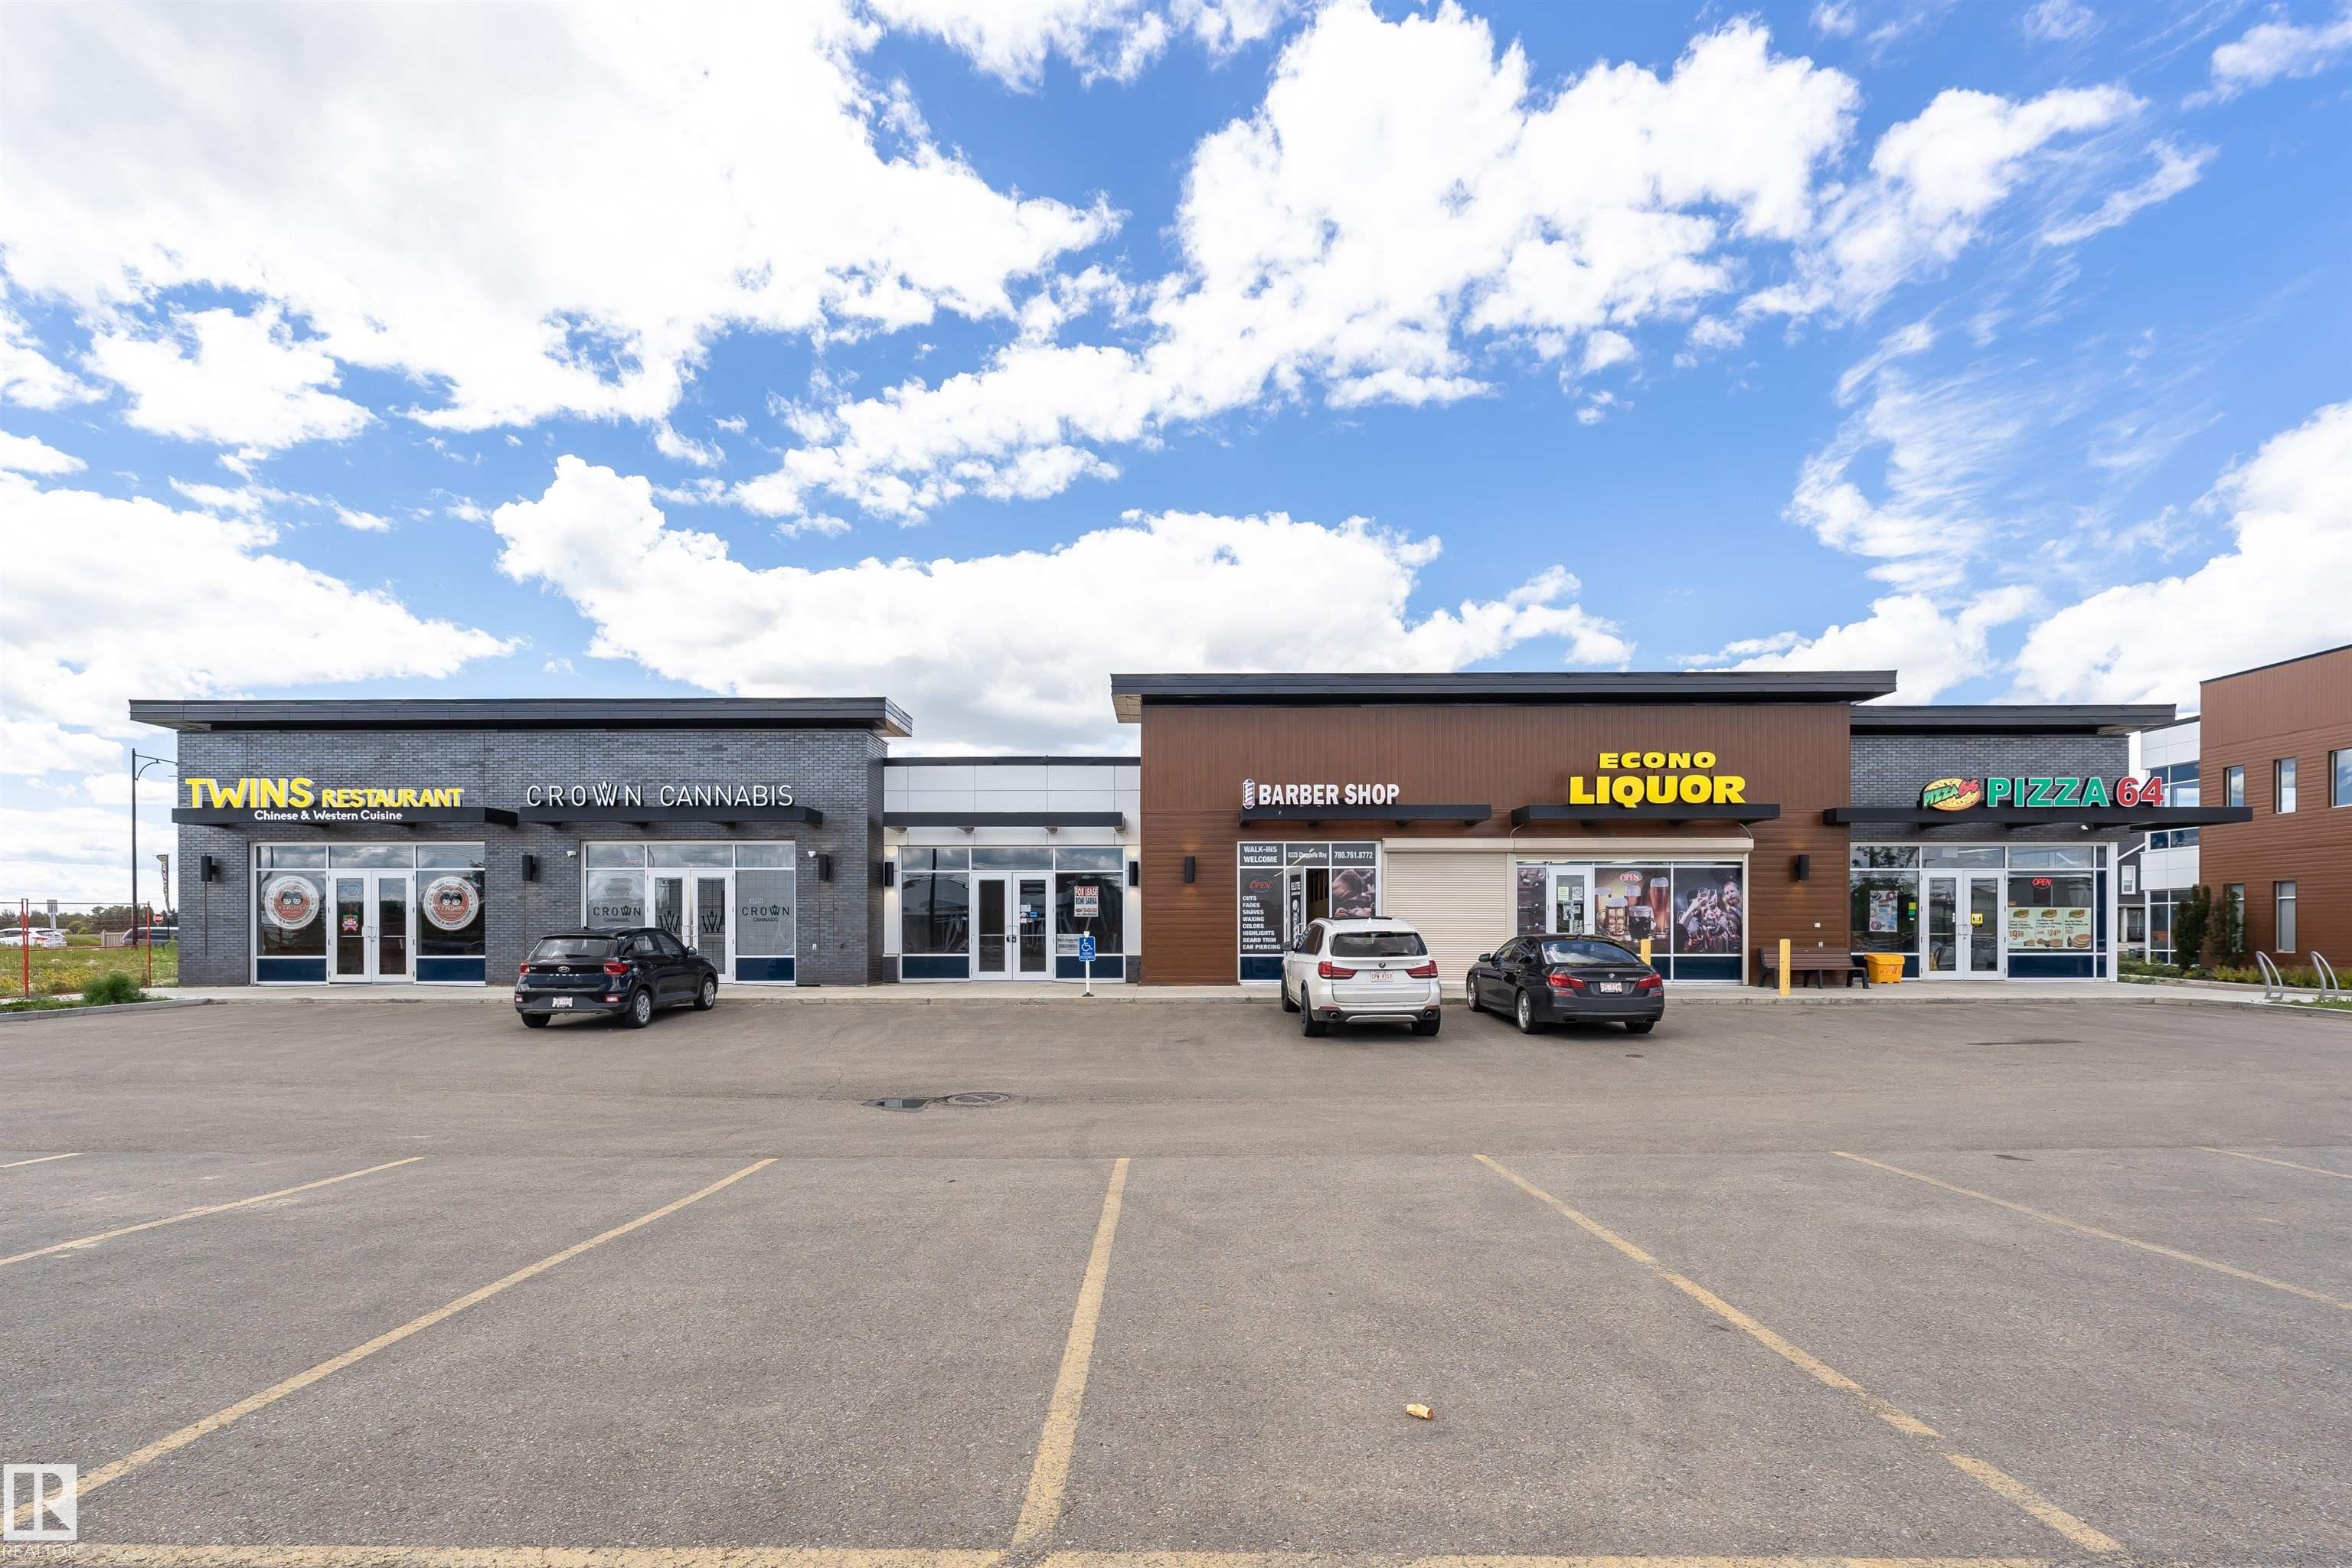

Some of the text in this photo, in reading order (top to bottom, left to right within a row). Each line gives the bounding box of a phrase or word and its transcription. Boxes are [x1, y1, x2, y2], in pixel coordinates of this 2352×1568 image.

[1599, 750, 1716, 769] ECONO
[185, 777, 465, 808] TWINS RESTAURANT
[527, 780, 793, 807] CROWN CANNABIS
[1259, 783, 1400, 805] BARBER SHOP
[1569, 774, 1746, 808] LIQUOR
[1922, 784, 1959, 808] PIZZA
[1987, 776, 2165, 808] PIZZA 64
[253, 809, 403, 821] Chinese & Western Cuisine
[1334, 851, 1374, 859] 780.761.8772
[1291, 881, 1301, 890] ELITE
[1619, 874, 1640, 882] OPEN
[1075, 887, 1098, 896] FOR LEASE
[593, 904, 641, 916] CROWN
[741, 904, 790, 916] CROWN
